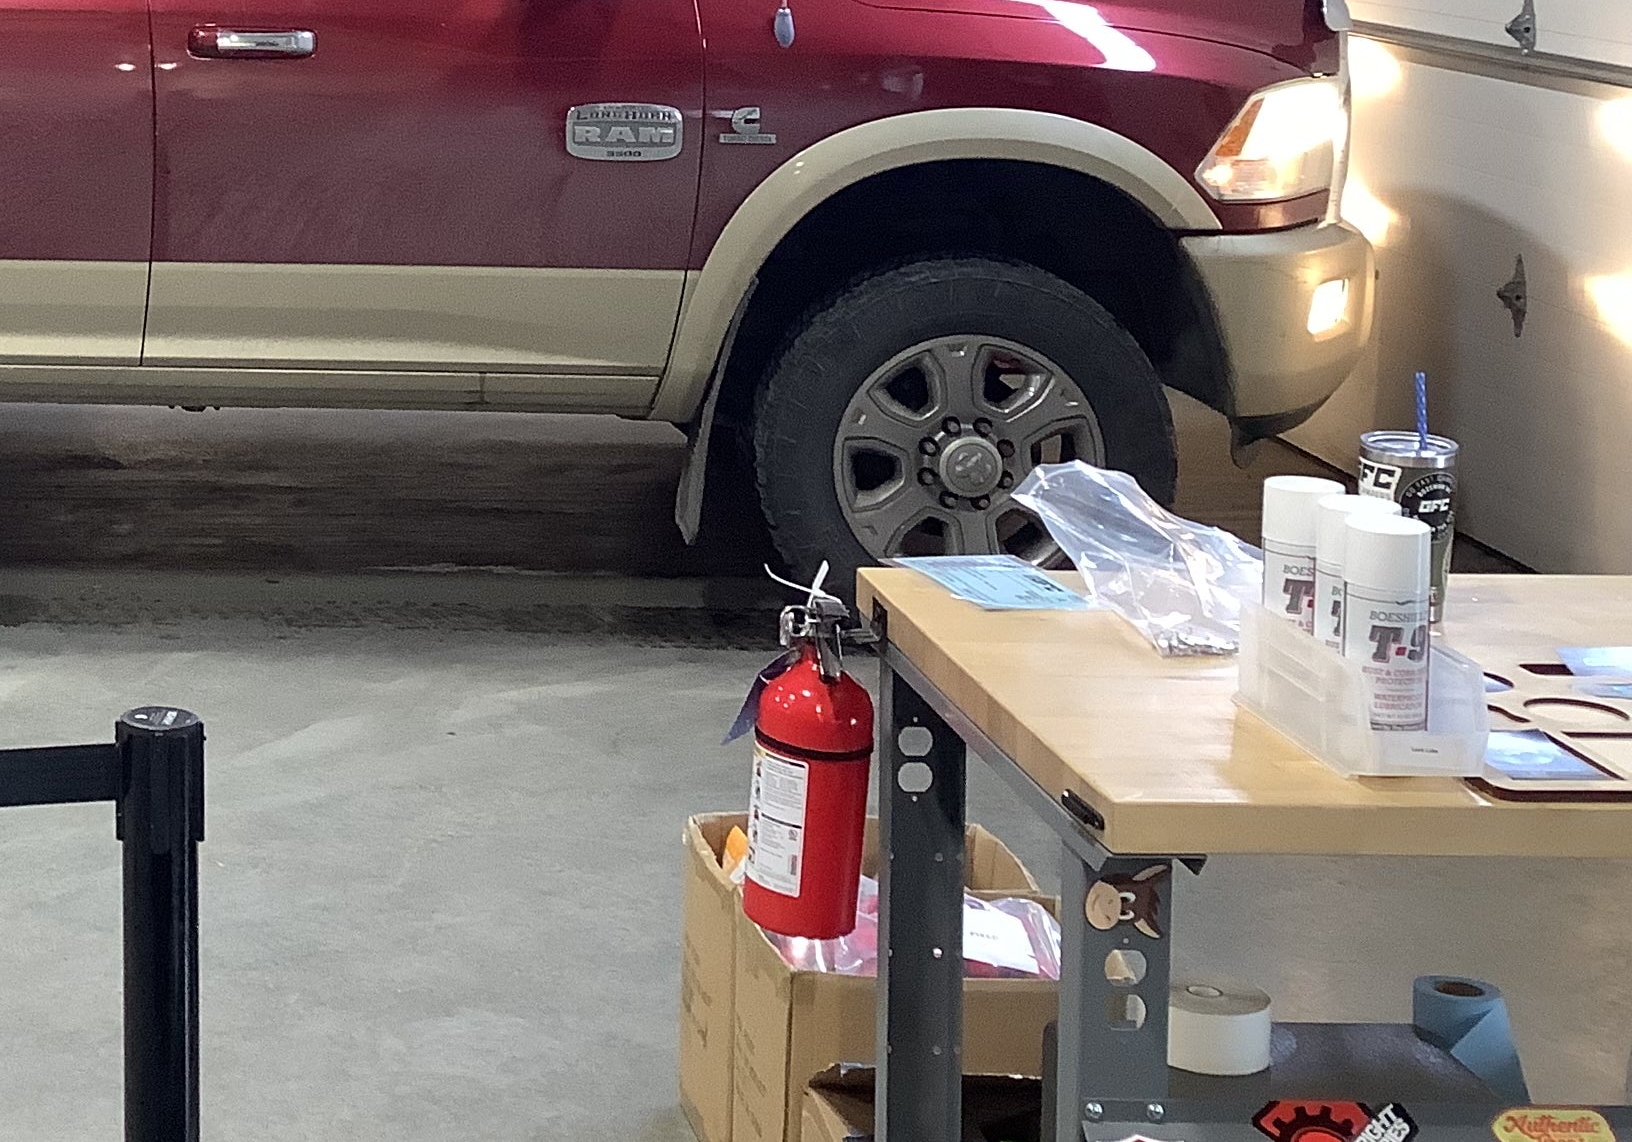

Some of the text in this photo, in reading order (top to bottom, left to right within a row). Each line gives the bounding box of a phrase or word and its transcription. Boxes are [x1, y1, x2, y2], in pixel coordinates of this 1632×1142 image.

[574, 125, 674, 143] RAM
[1360, 462, 1396, 490] FC
[1418, 498, 1450, 513] GFC
[1503, 1115, 1599, 1139] Authentic
